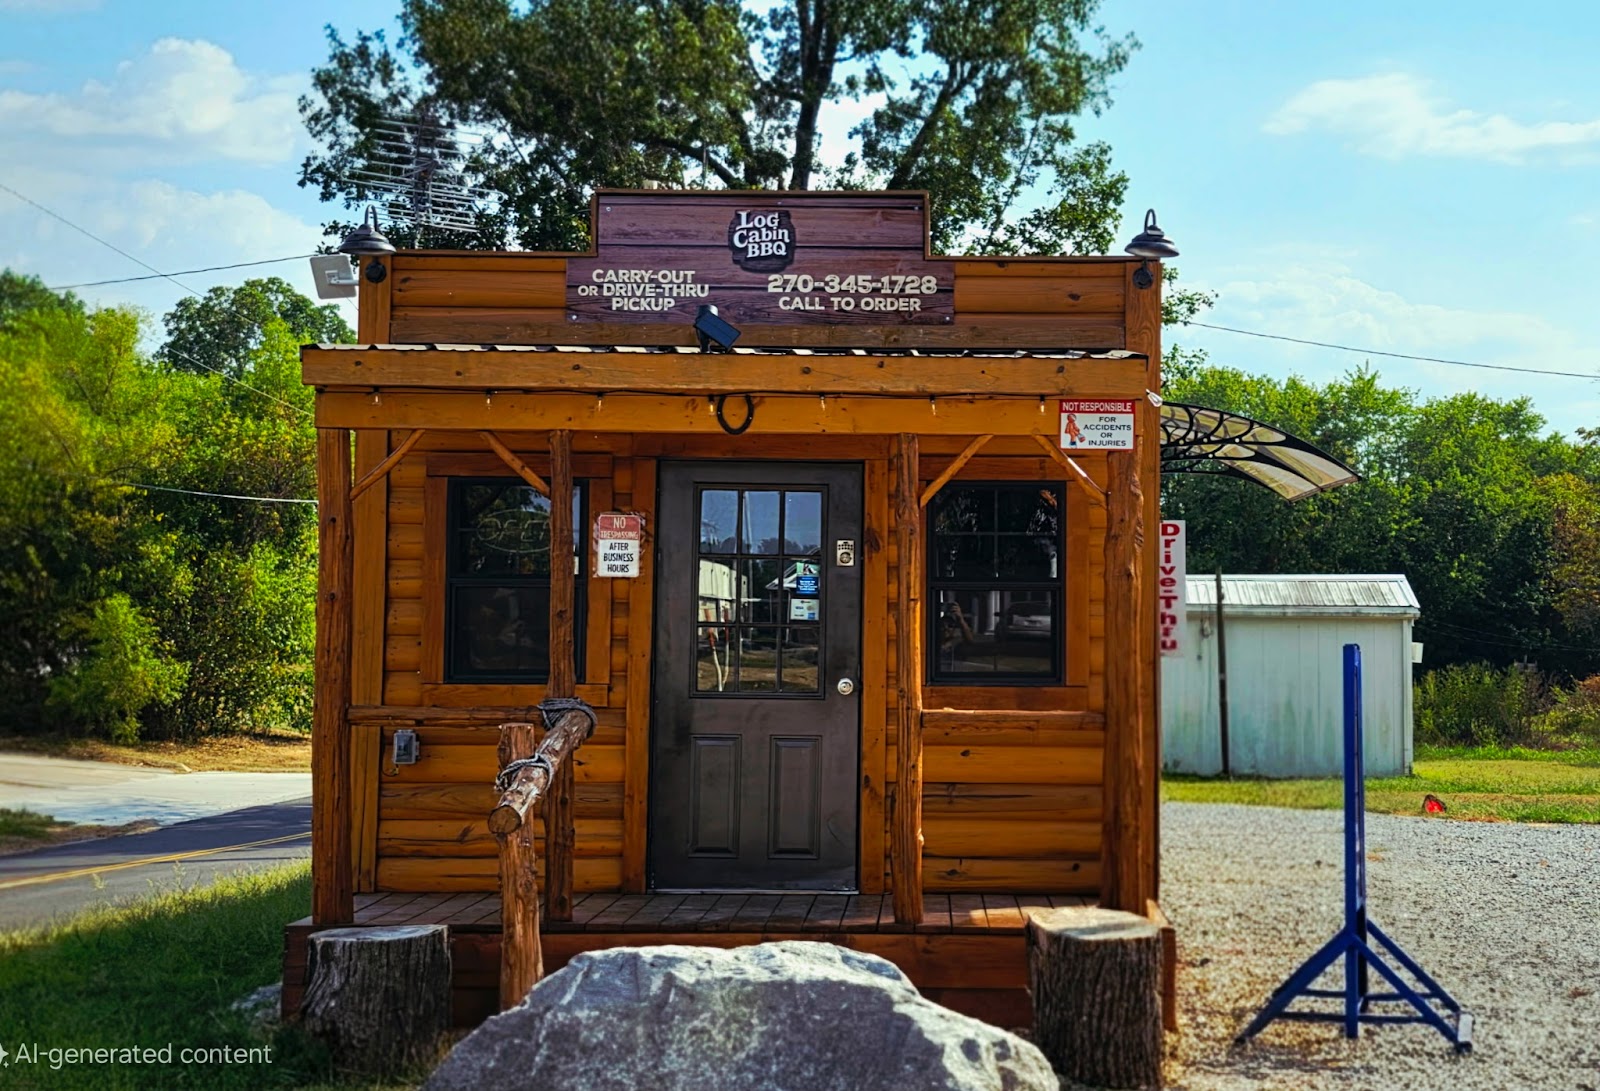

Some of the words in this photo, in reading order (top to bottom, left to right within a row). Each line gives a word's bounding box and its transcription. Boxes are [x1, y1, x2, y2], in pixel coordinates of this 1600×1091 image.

[733, 227, 790, 249] Cabin
[746, 241, 787, 258] BBQ
[592, 269, 696, 283] CARRY-OUT
[577, 285, 599, 296] OR
[603, 283, 709, 297] DRIVE-THRU
[767, 274, 938, 294] 270-345-1728
[612, 297, 675, 311] PICKUP
[778, 296, 826, 311] CALL
[830, 297, 856, 311] TO
[860, 297, 922, 311] ORDER
[1062, 402, 1079, 411] NOT
[1079, 402, 1132, 412] RESPONSIBLE
[613, 517, 627, 529] NO
[600, 530, 639, 539] TRESPASSING
[609, 542, 629, 551] AFTER
[603, 553, 634, 562] BUSINESS
[607, 564, 630, 573] HOURS
[1159, 523, 1181, 651] Drive-Thru
